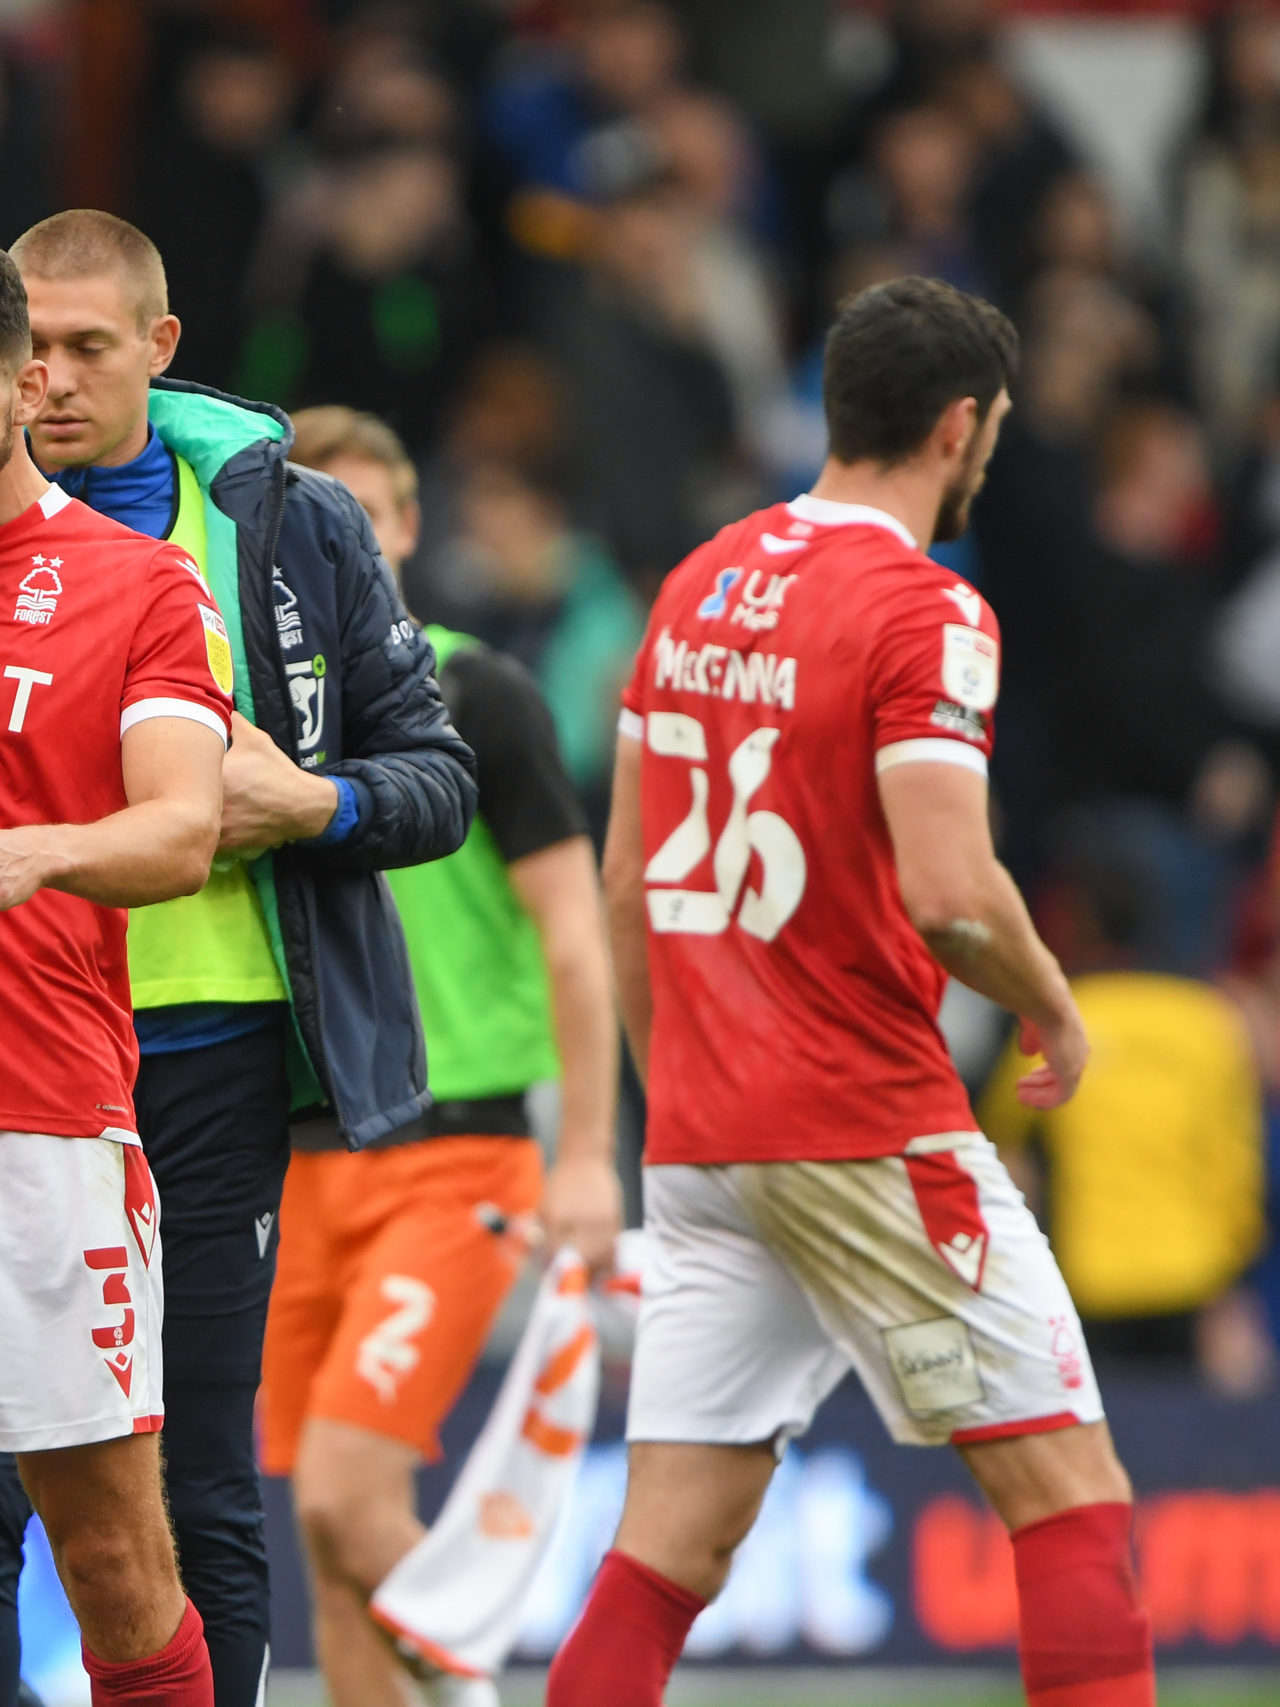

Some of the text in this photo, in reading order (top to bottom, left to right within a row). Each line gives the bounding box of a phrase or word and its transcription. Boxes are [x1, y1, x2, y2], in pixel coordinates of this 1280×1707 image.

[13, 608, 54, 624] FOREST
[643, 711, 807, 944] 26
[356, 1273, 438, 1408] 2
